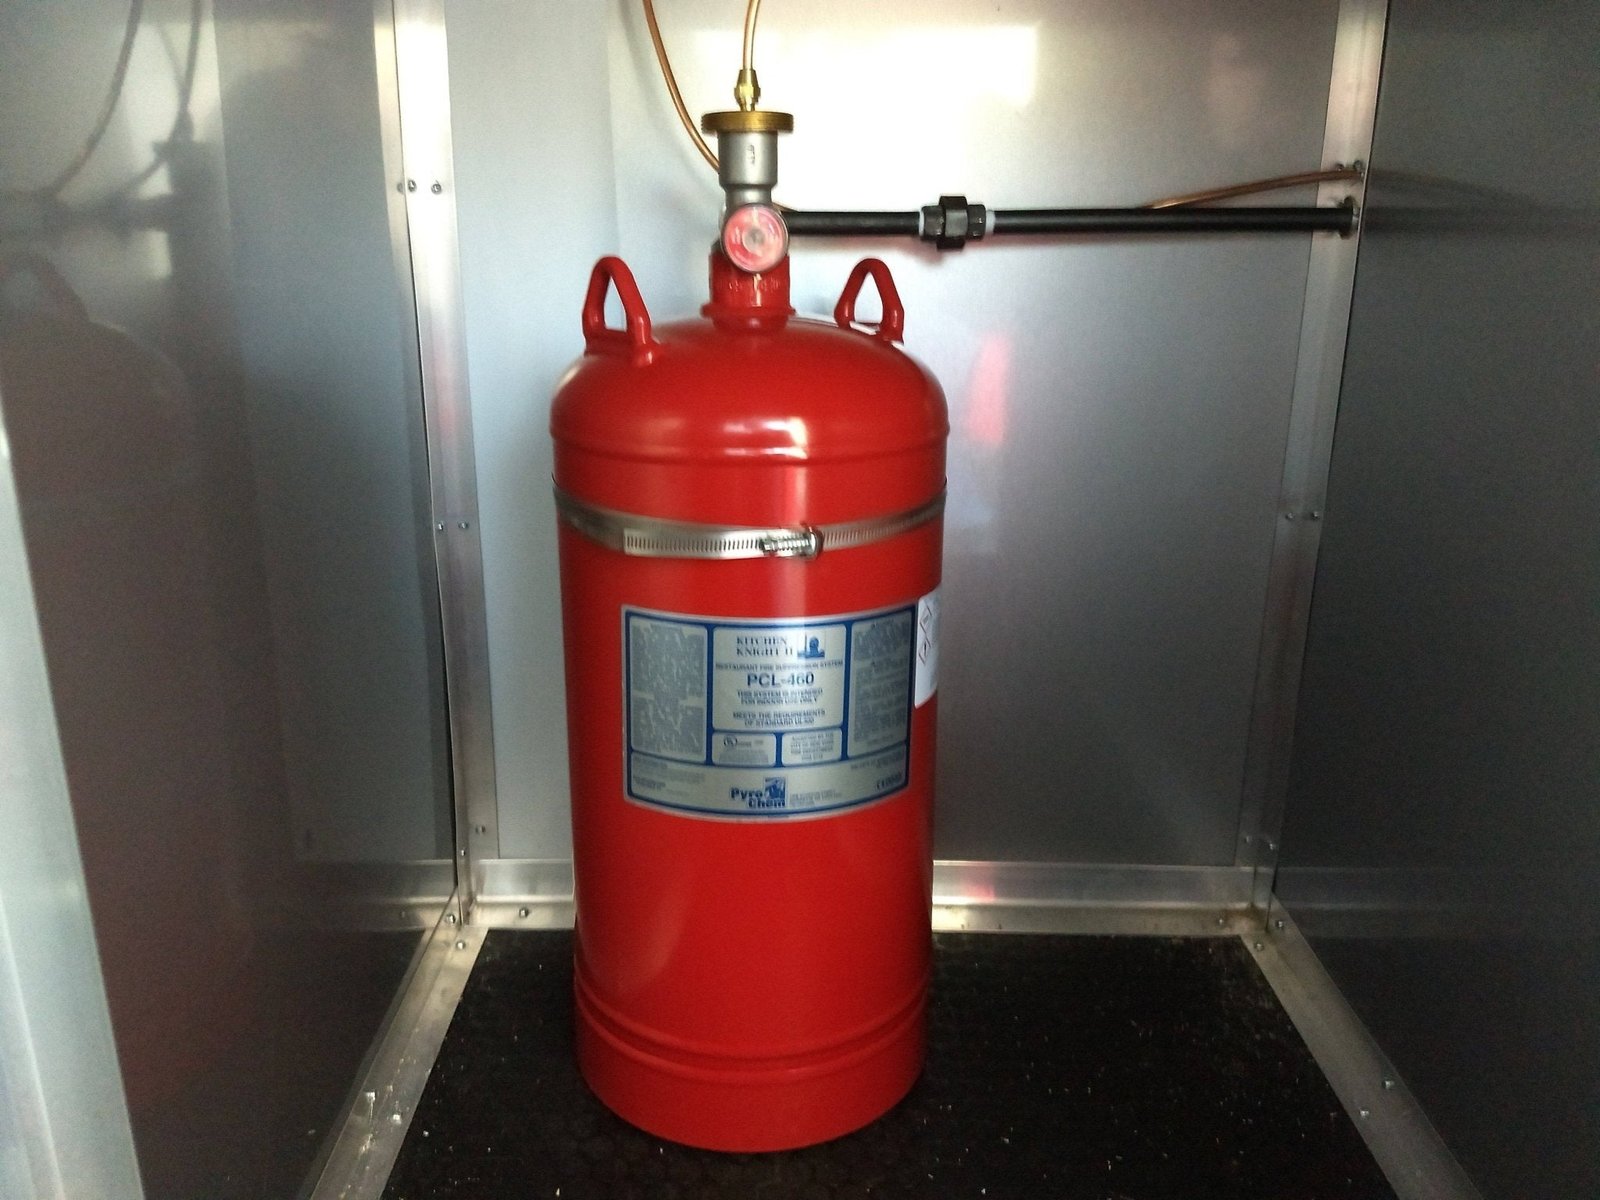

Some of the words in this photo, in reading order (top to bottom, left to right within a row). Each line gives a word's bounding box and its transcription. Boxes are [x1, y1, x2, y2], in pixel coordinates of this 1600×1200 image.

[736, 636, 787, 645] KITCHEN
[736, 648, 779, 656] KNIGHT
[747, 672, 815, 687] PCL-460
[730, 787, 763, 800] Pyro
[748, 799, 786, 808] Chem
